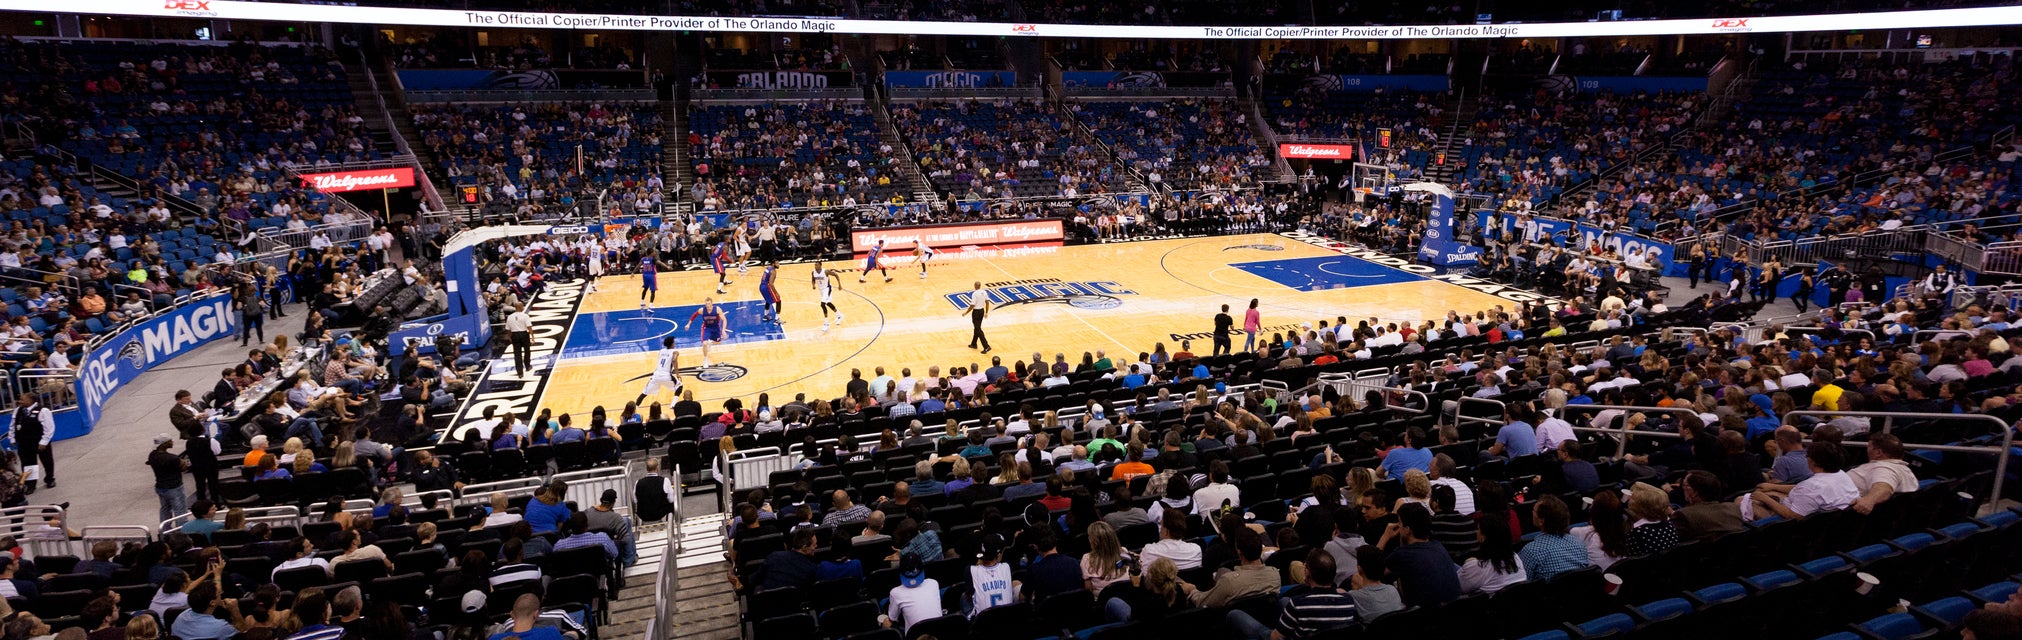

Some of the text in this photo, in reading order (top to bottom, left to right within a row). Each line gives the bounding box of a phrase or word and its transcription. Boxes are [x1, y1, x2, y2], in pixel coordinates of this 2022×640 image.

[165, 0, 209, 10] DEX
[465, 13, 836, 32] The Official Copier/Printer Provider of The Orlando Magic
[1012, 23, 1036, 31] DEX
[1712, 19, 1749, 27] DEX
[1204, 26, 1519, 39] The Official Copier/Printer Provider of The Orlando Magic
[736, 71, 828, 90] ORLANDO
[925, 71, 980, 89] MAGIC
[1347, 78, 1361, 86] 108
[1583, 80, 1600, 89] 109
[1289, 145, 1341, 158] Walgreens
[314, 172, 398, 191] Walgreens
[1050, 201, 1073, 210] MAGIC
[552, 226, 589, 235] GEICO
[1002, 224, 1060, 241] Walgreens
[859, 233, 922, 249] Walgreens
[985, 277, 1062, 288] ORLANDO
[944, 281, 1140, 310] MAGIC
[82, 348, 119, 422] PURE
[982, 579, 1007, 592] OLADIPO
